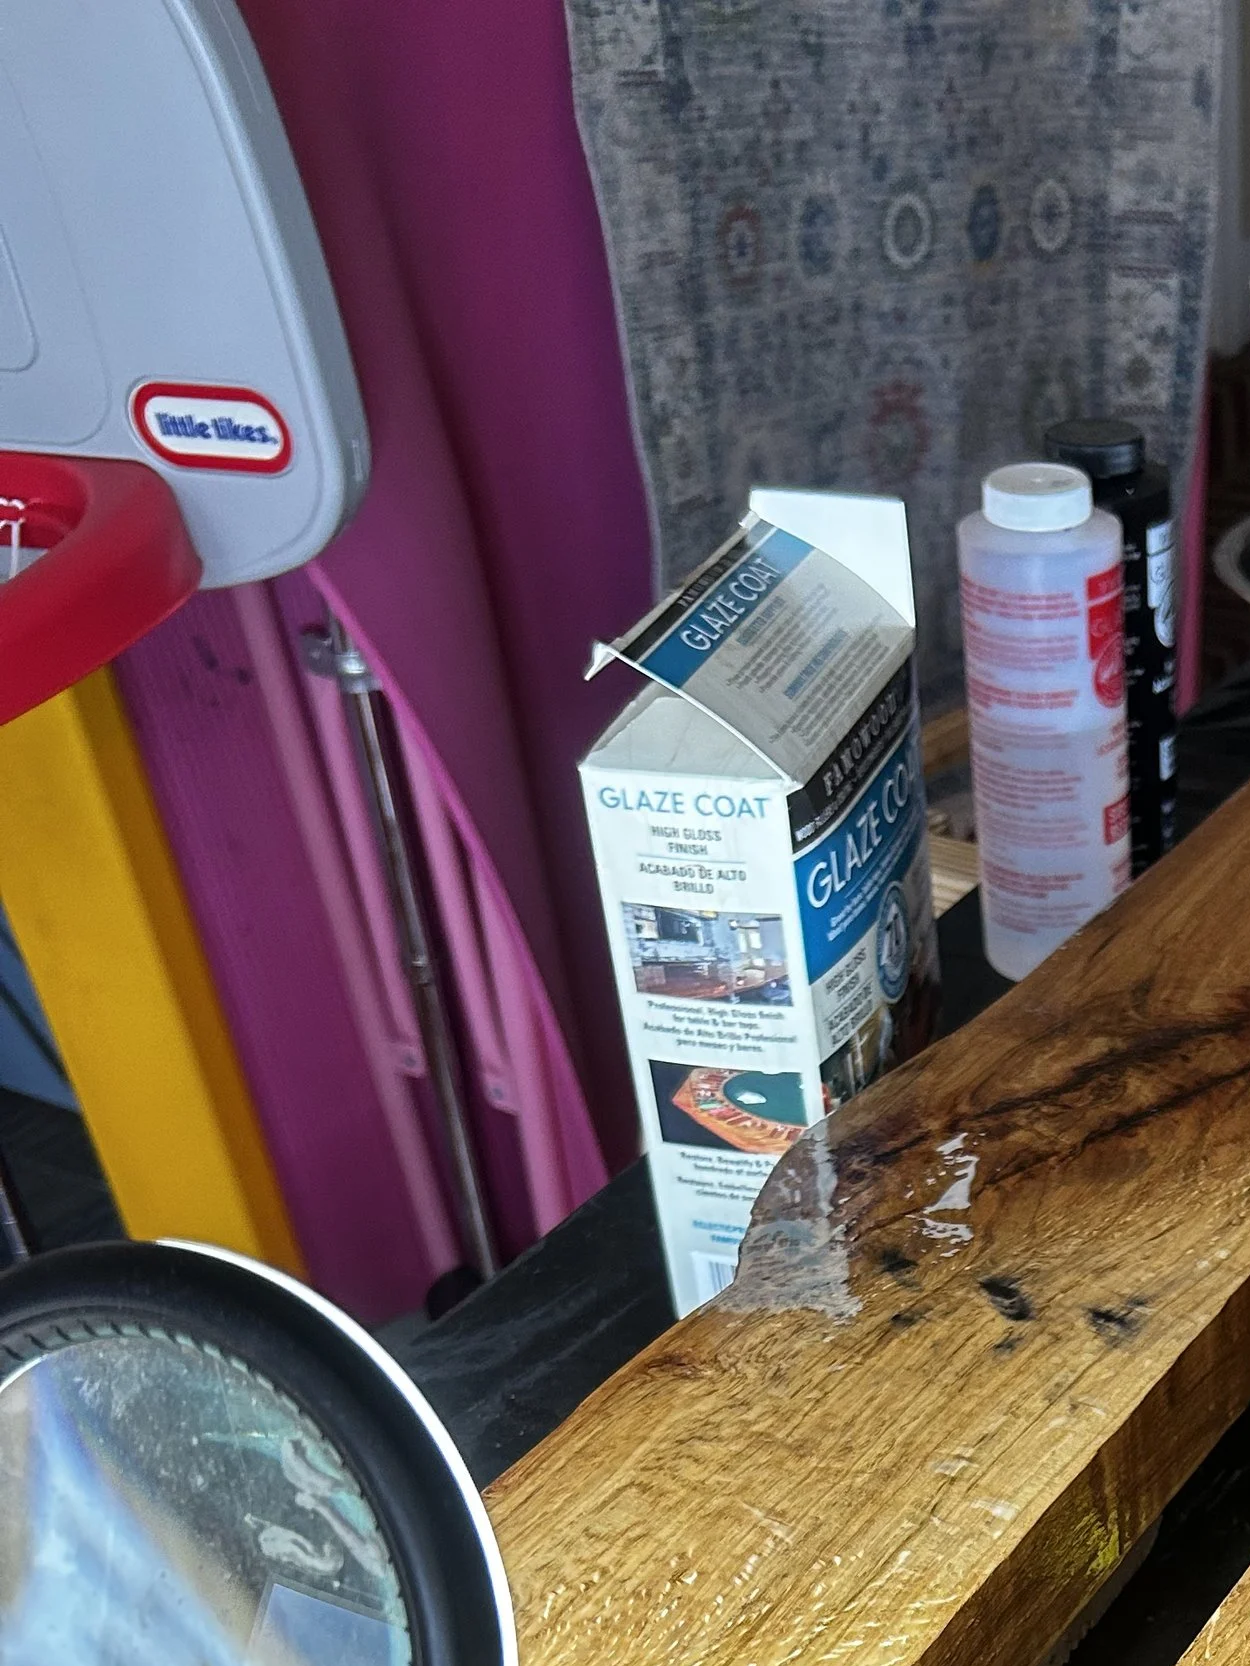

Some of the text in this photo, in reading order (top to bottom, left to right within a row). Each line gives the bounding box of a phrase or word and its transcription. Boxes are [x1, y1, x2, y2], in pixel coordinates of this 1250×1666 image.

[155, 411, 211, 439] little
[680, 595, 746, 651] GLAZE
[729, 557, 783, 602] COAT
[599, 786, 771, 819] GLAZE COAT
[650, 825, 722, 842] HIGH GLOSS
[667, 842, 709, 856] FINISH
[806, 800, 884, 909] GLAZE
[639, 862, 747, 882] ACABADO DE ALTO
[672, 880, 715, 895] BRILLO
